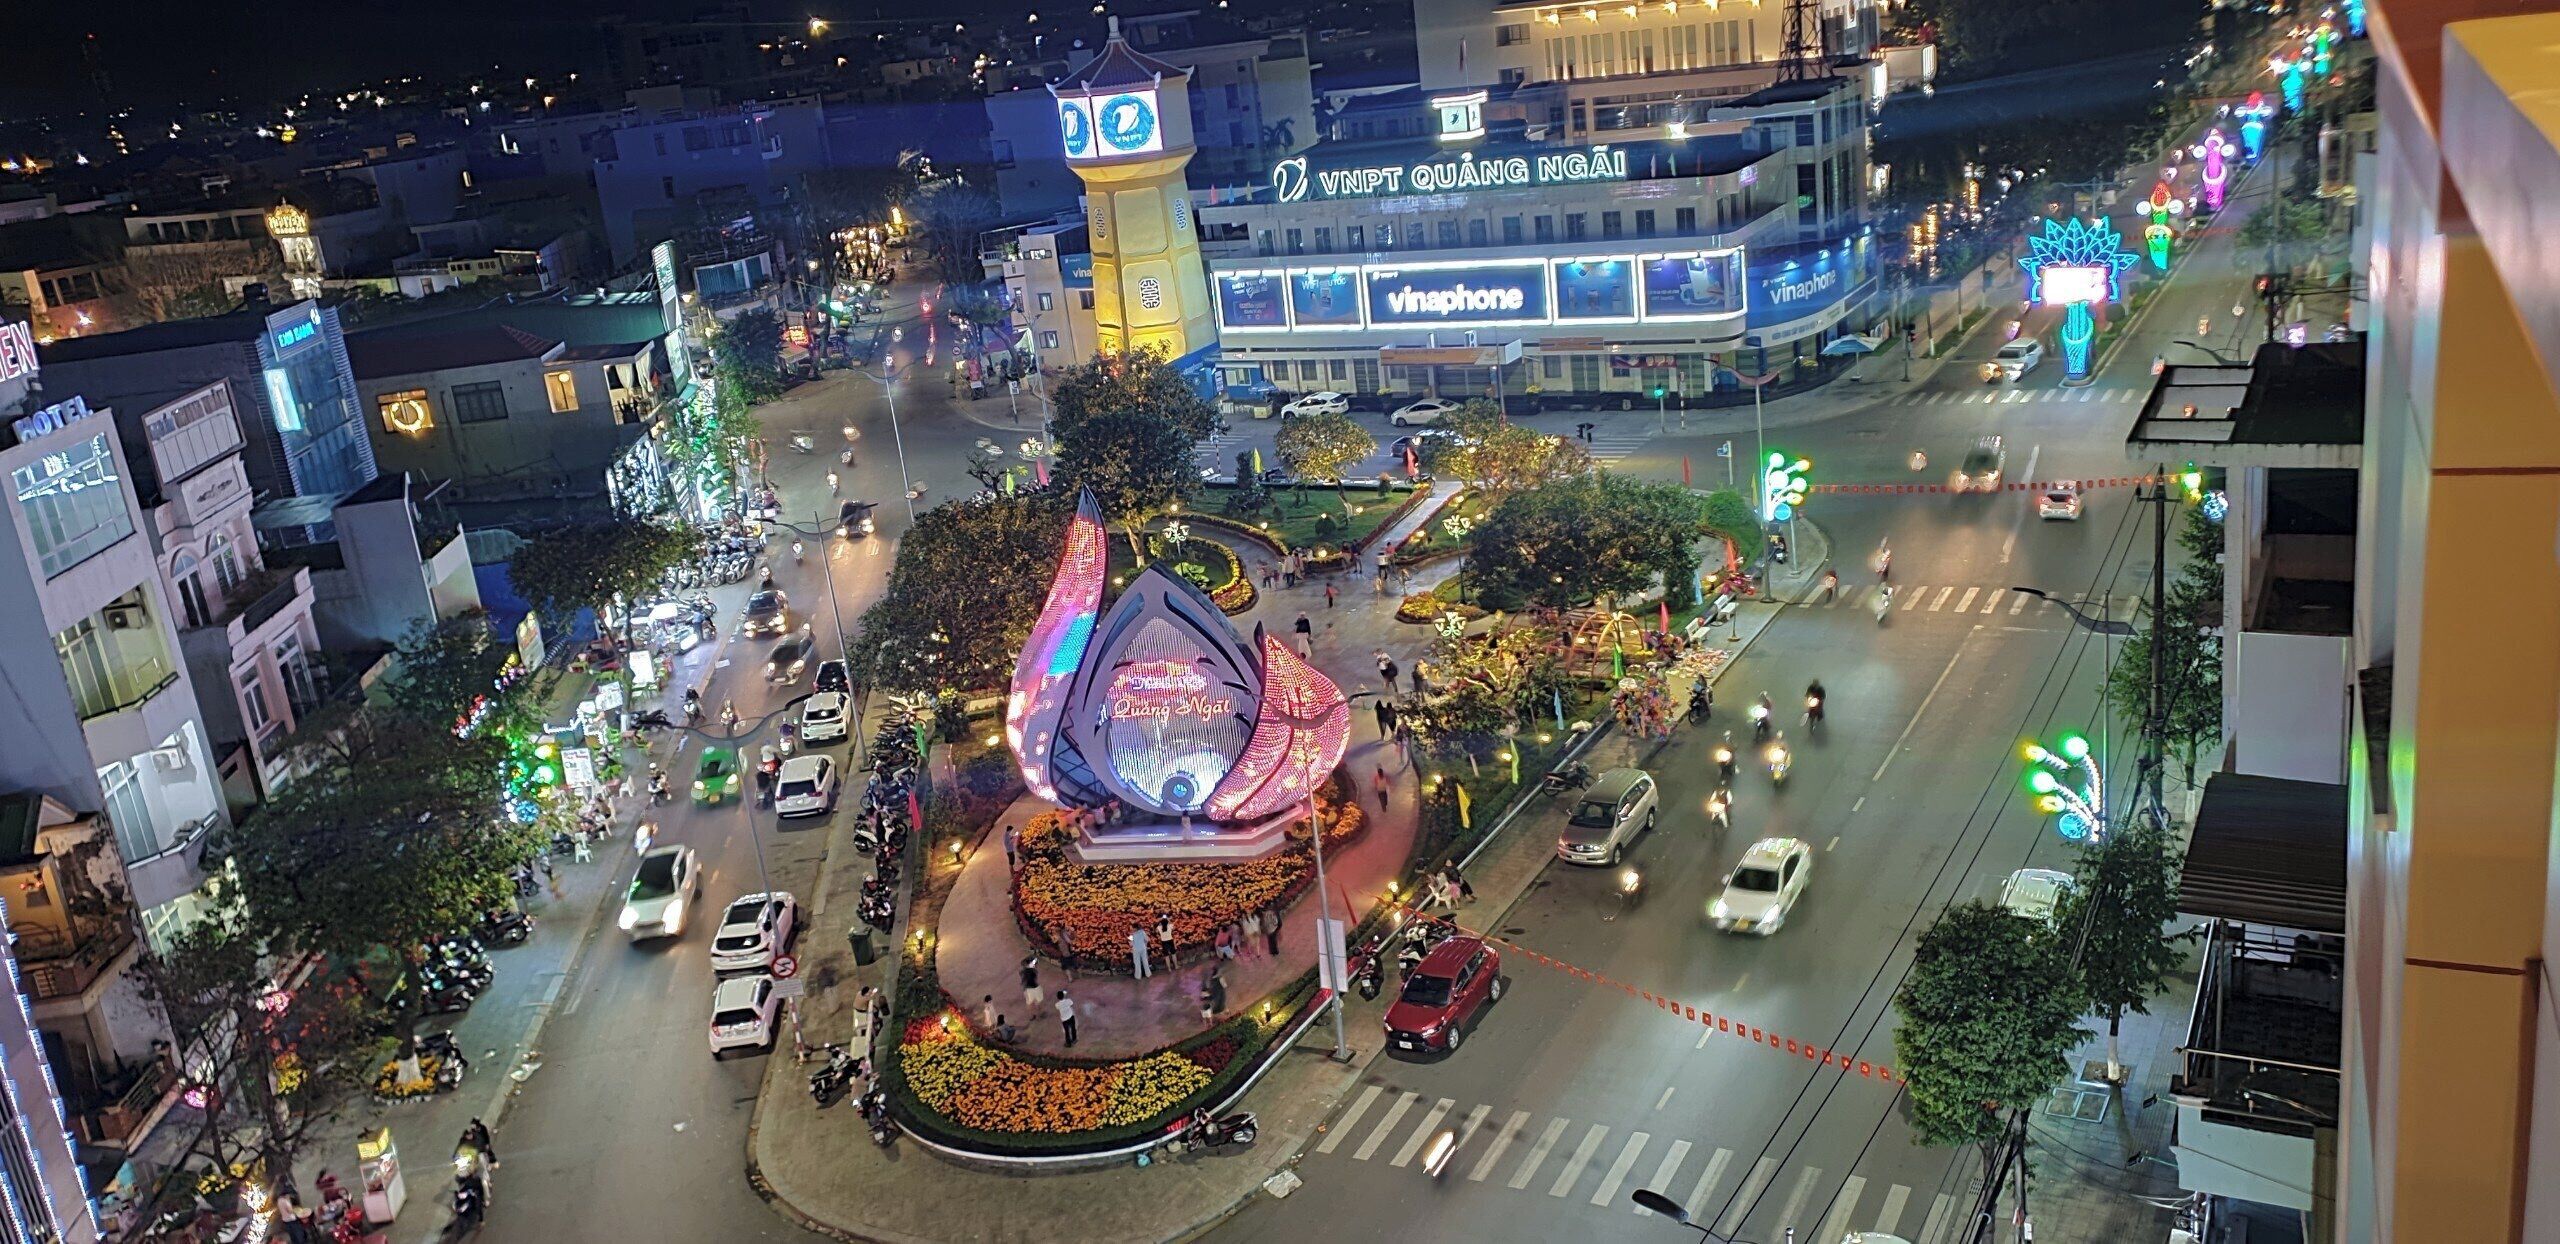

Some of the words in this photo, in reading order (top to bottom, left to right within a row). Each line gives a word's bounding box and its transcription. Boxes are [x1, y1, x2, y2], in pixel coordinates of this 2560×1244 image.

[1319, 167, 1403, 196] VNPT
[1411, 152, 1530, 192] QUẢNG
[1538, 144, 1626, 183] NGÃI
[1388, 284, 1524, 315] vinaphone
[1769, 270, 1836, 305] vinaphone
[12, 395, 94, 443] HOTEL
